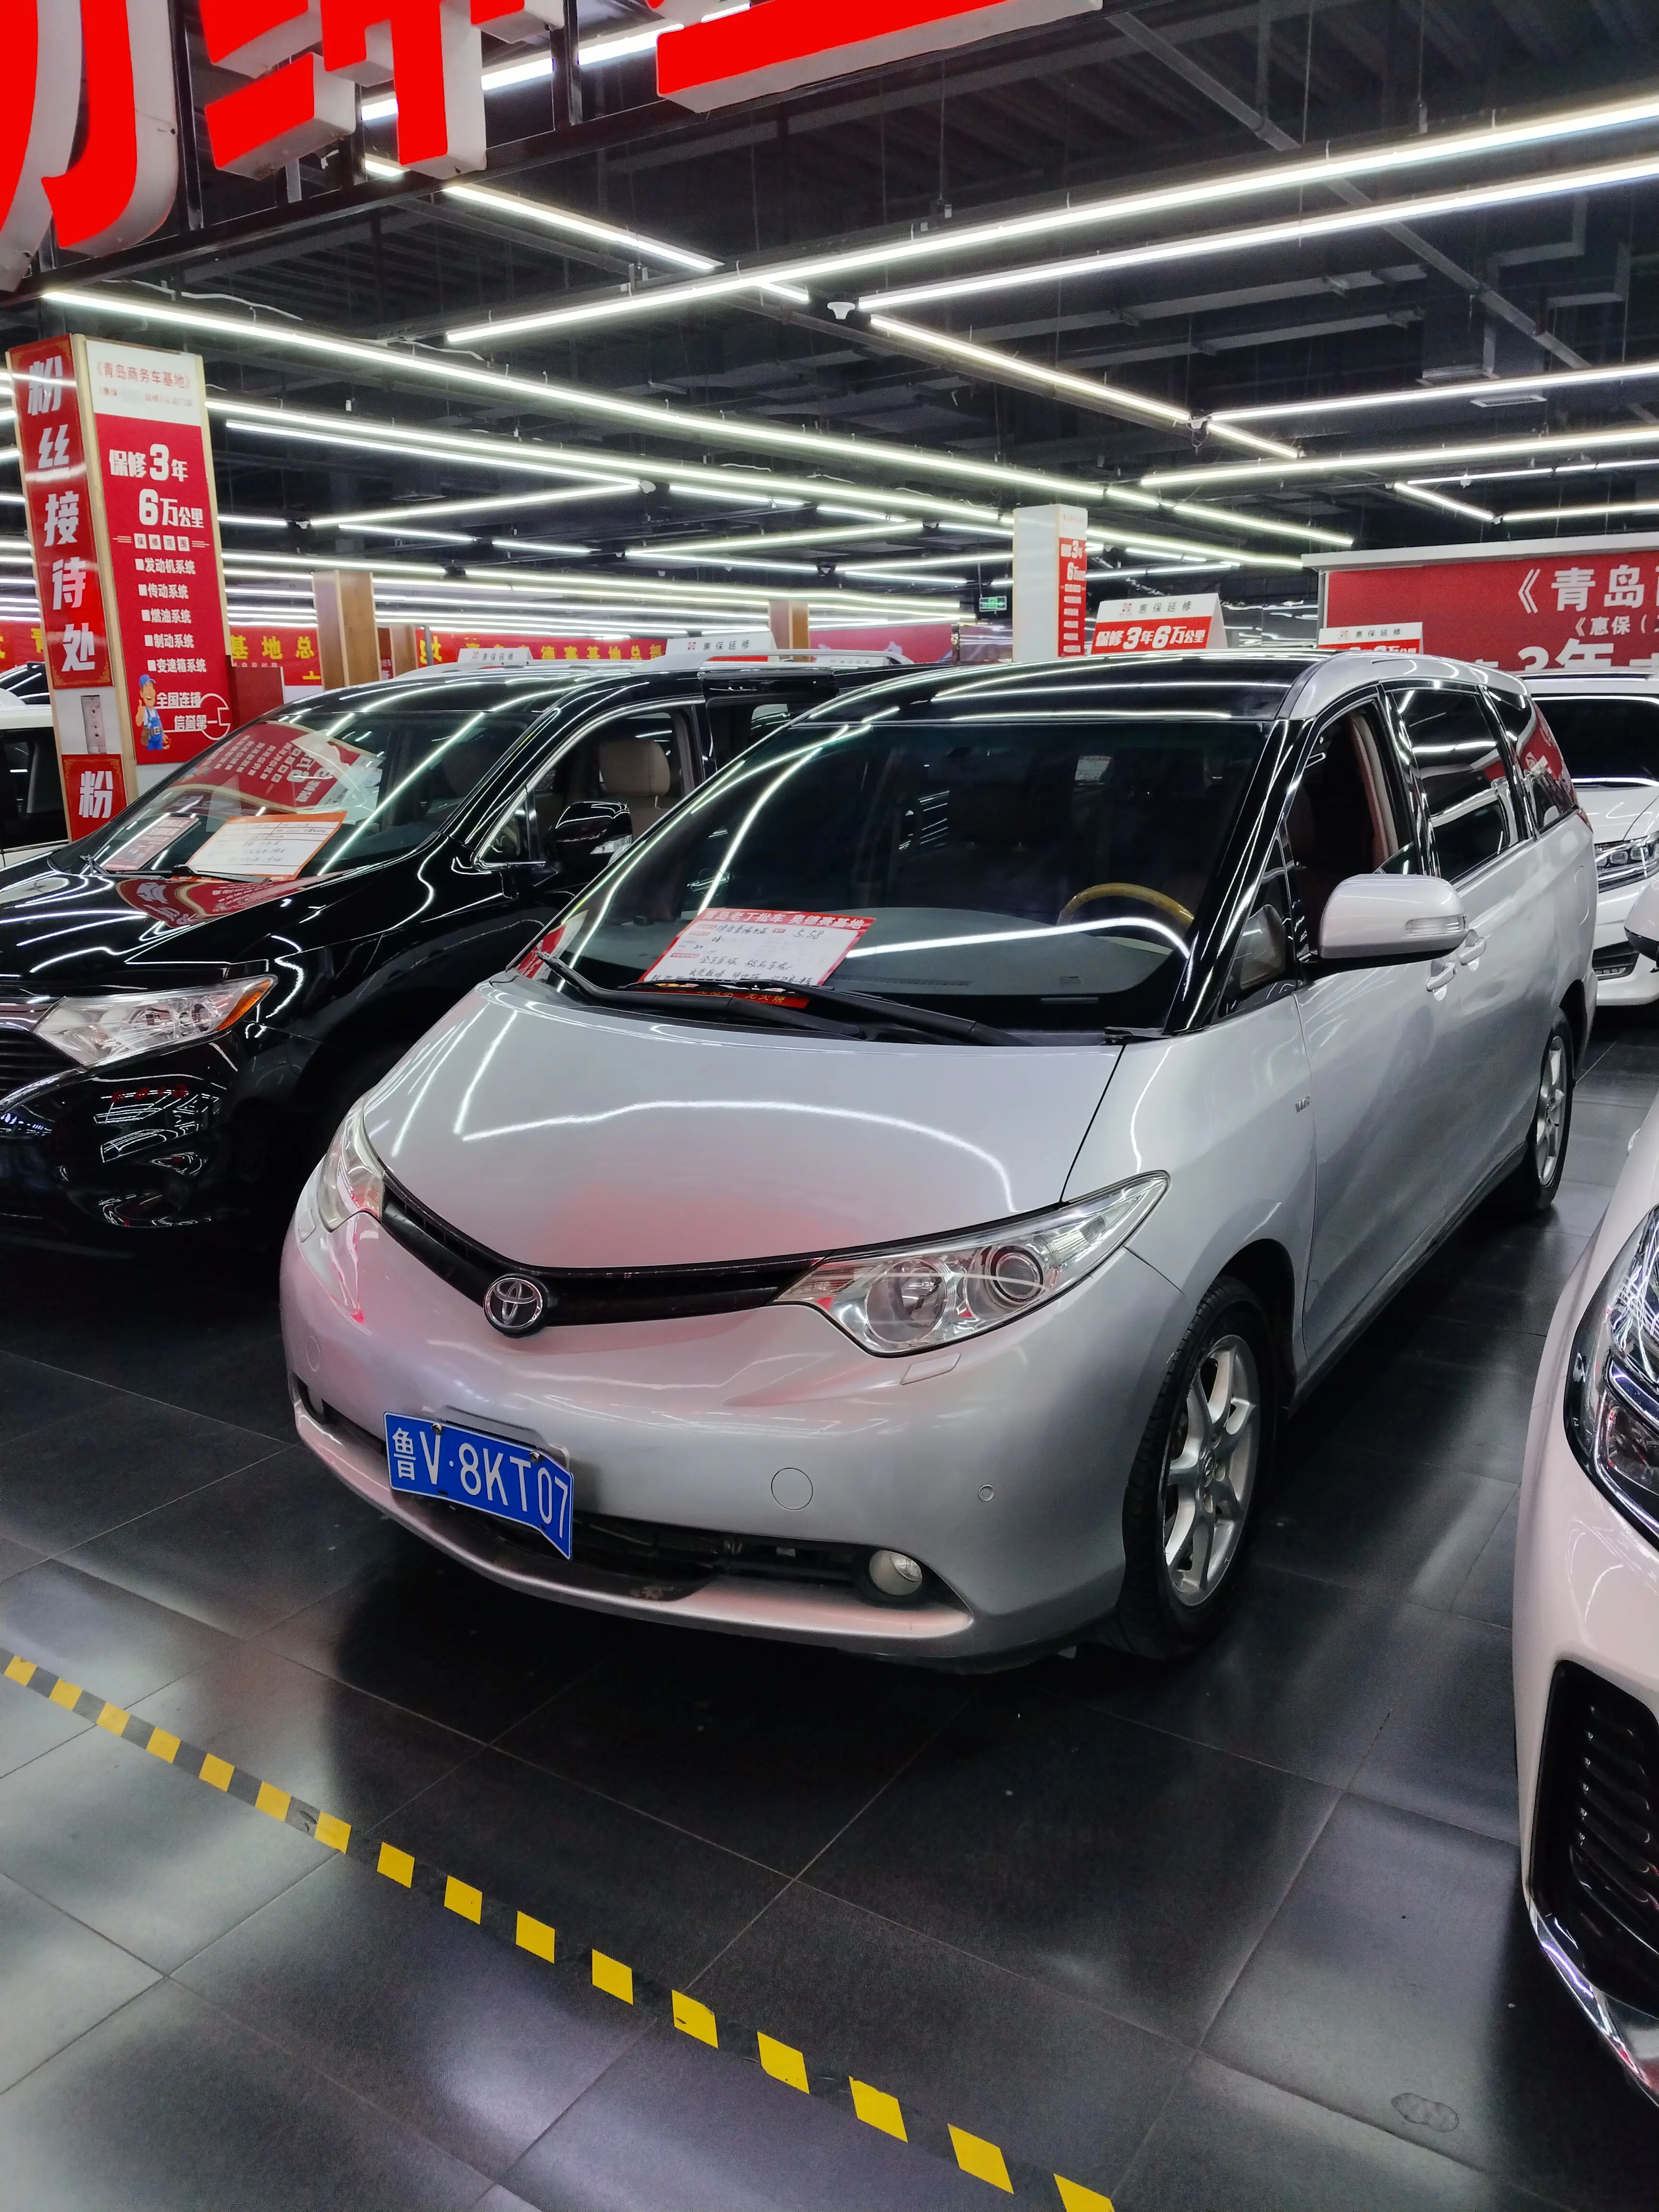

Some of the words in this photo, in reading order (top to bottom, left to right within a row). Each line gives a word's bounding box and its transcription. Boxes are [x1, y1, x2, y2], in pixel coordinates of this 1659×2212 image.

[109, 444, 189, 482] 保修3年
[27, 356, 96, 672] 粉丝接待处
[139, 489, 204, 529] 6万公里
[145, 557, 196, 575] 发动机系统
[148, 583, 189, 599] 传动系统
[1518, 564, 1659, 614] 《青岛
[151, 609, 192, 624] 燃油系统
[154, 634, 194, 649] 制动系统
[1095, 625, 1206, 650] 保修3年6万公里
[156, 658, 207, 673] 变速箱系统
[156, 692, 201, 708] 全国连锁
[174, 714, 218, 731] 信誉第一
[80, 771, 113, 818] 粉
